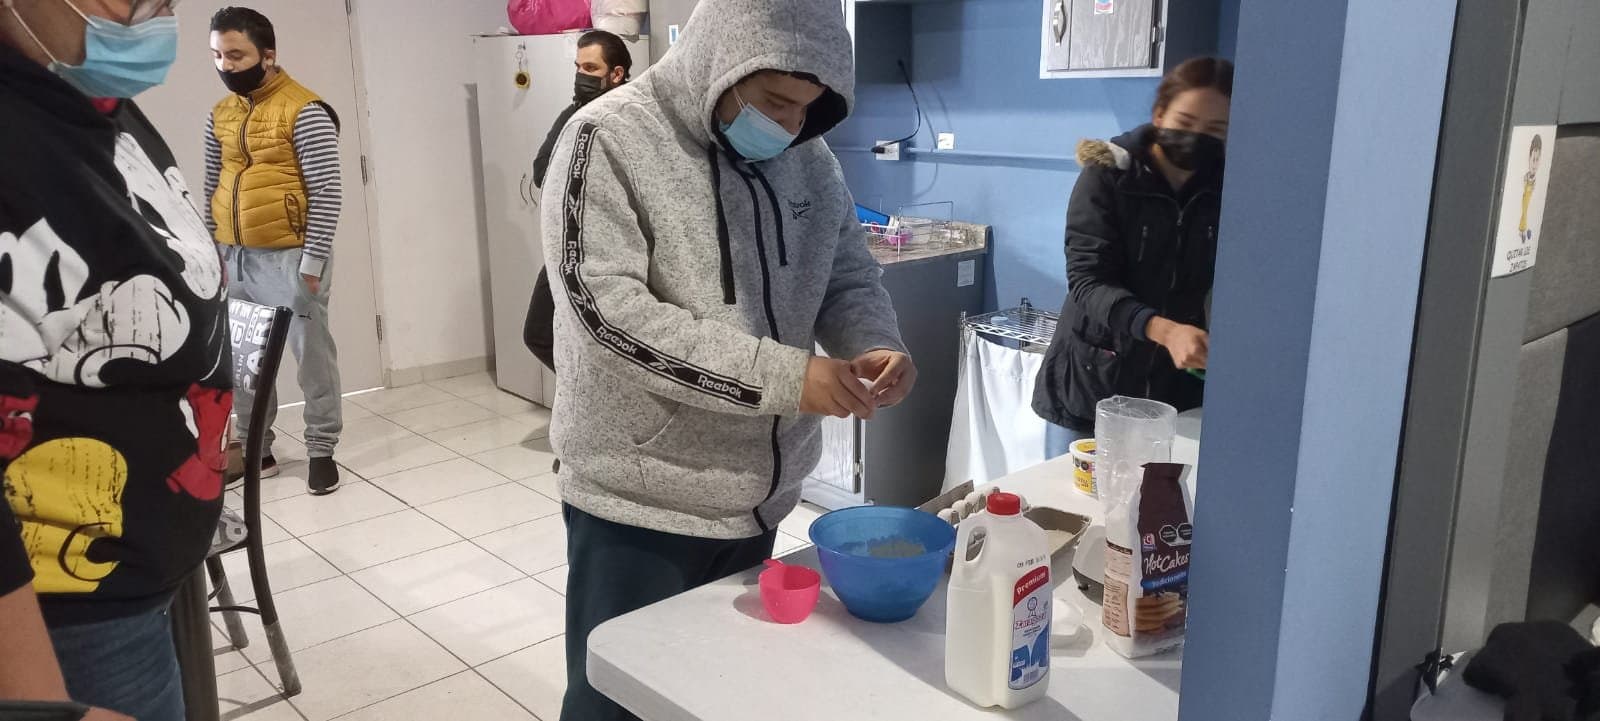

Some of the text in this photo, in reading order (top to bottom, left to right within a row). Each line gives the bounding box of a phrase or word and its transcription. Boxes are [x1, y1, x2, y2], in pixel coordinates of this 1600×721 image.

[573, 133, 589, 179] Reebok
[564, 240, 578, 275] Reek
[697, 374, 742, 399] Reebok
